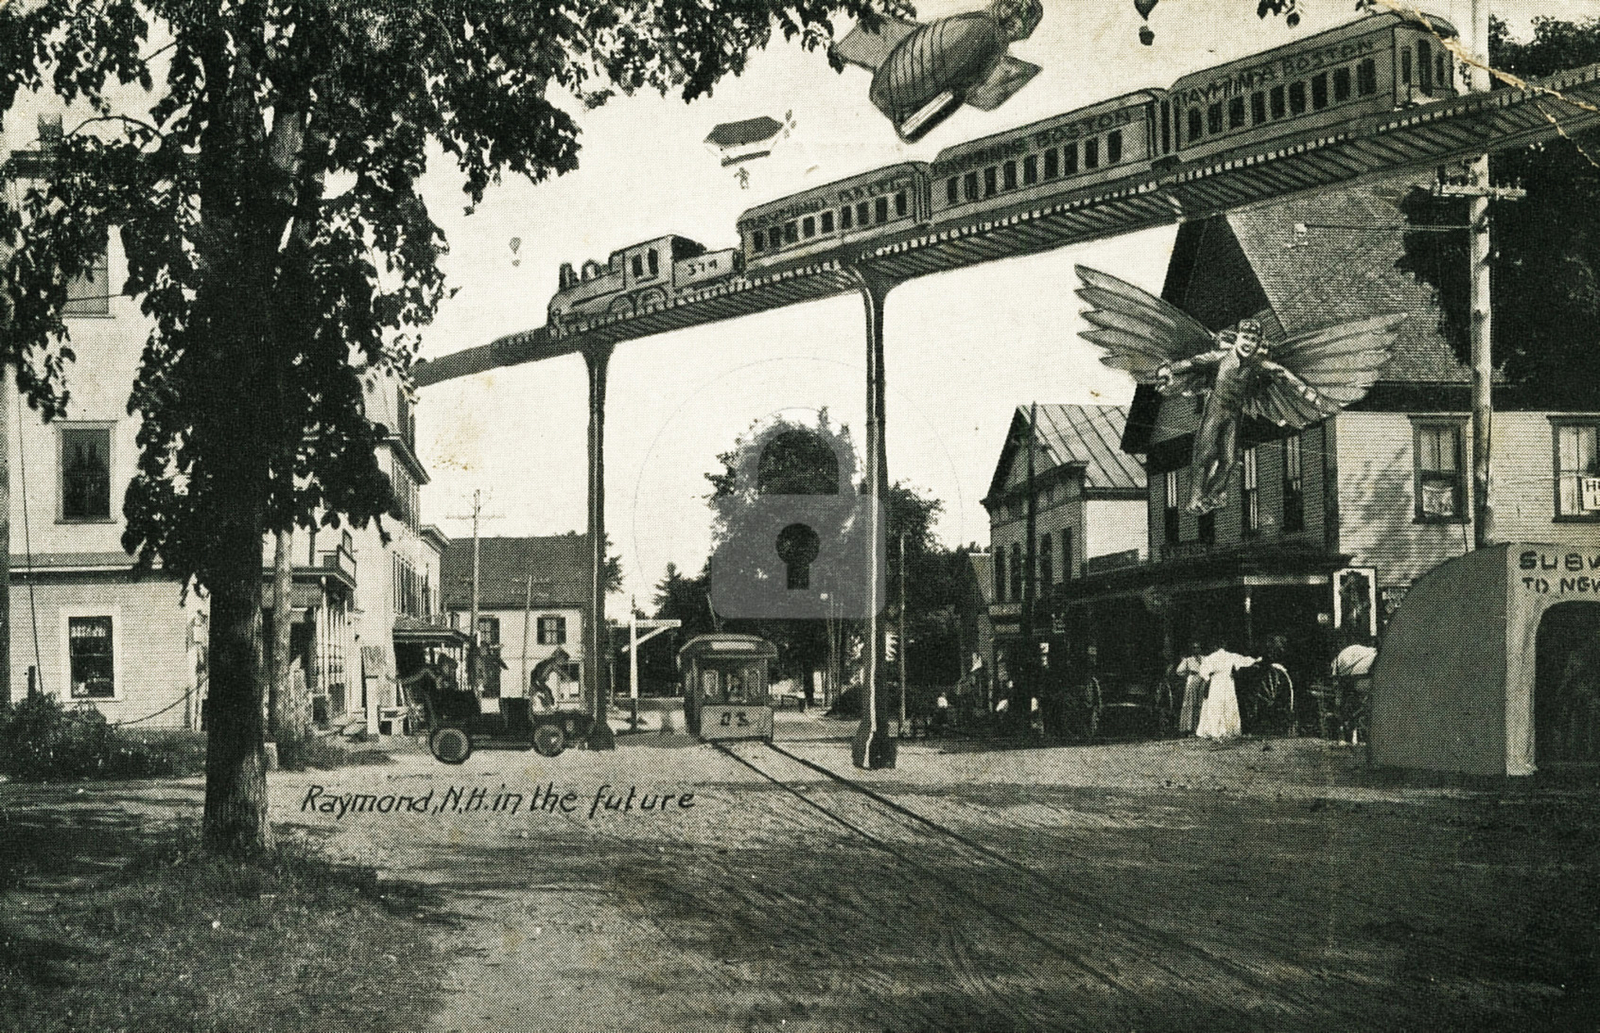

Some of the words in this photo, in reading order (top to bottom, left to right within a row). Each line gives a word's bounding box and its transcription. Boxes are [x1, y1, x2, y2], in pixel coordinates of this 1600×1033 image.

[1282, 40, 1373, 76] BOSTON
[1036, 110, 1131, 147] BOSTON
[1522, 577, 1549, 594] TO
